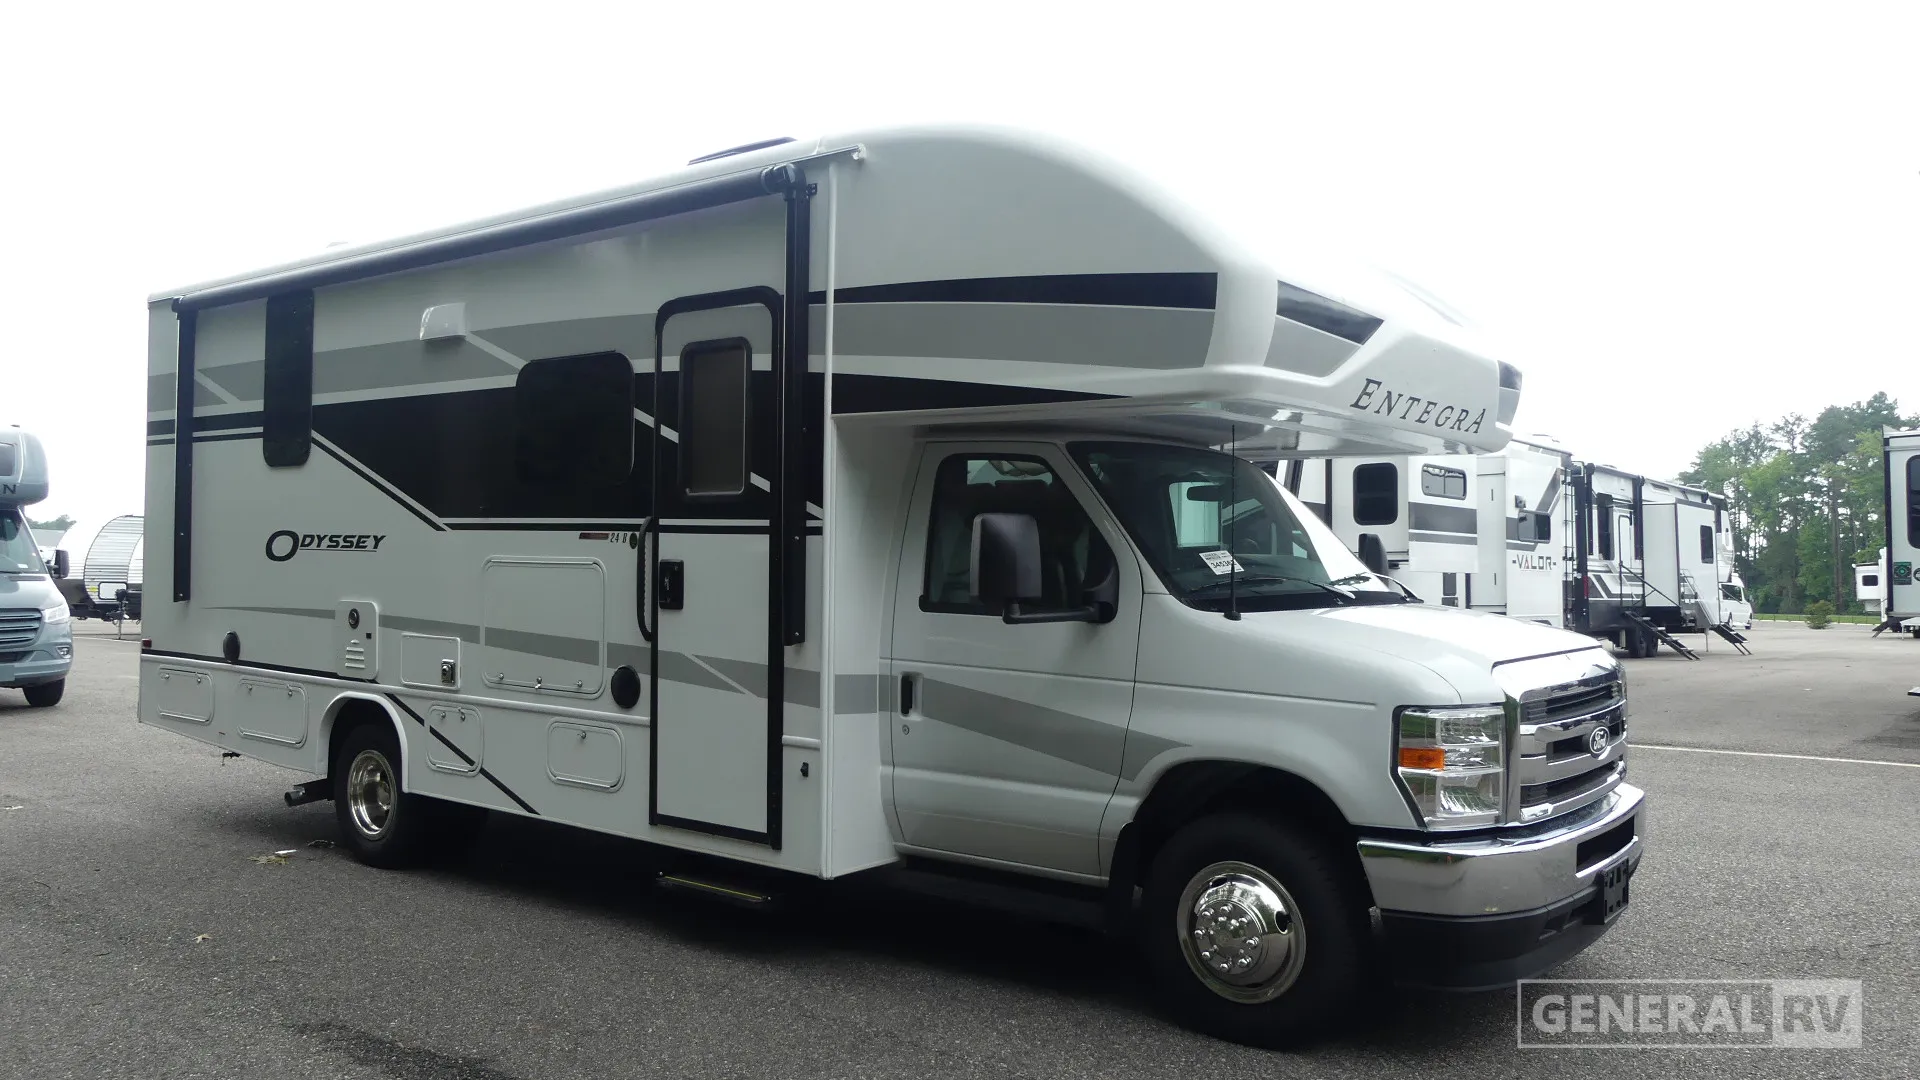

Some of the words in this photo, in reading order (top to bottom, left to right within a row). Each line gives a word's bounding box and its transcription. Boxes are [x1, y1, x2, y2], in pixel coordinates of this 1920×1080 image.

[1349, 378, 1486, 433] ENTEGRA
[265, 530, 386, 562] ODYSSEY
[1593, 730, 1607, 750] Ford
